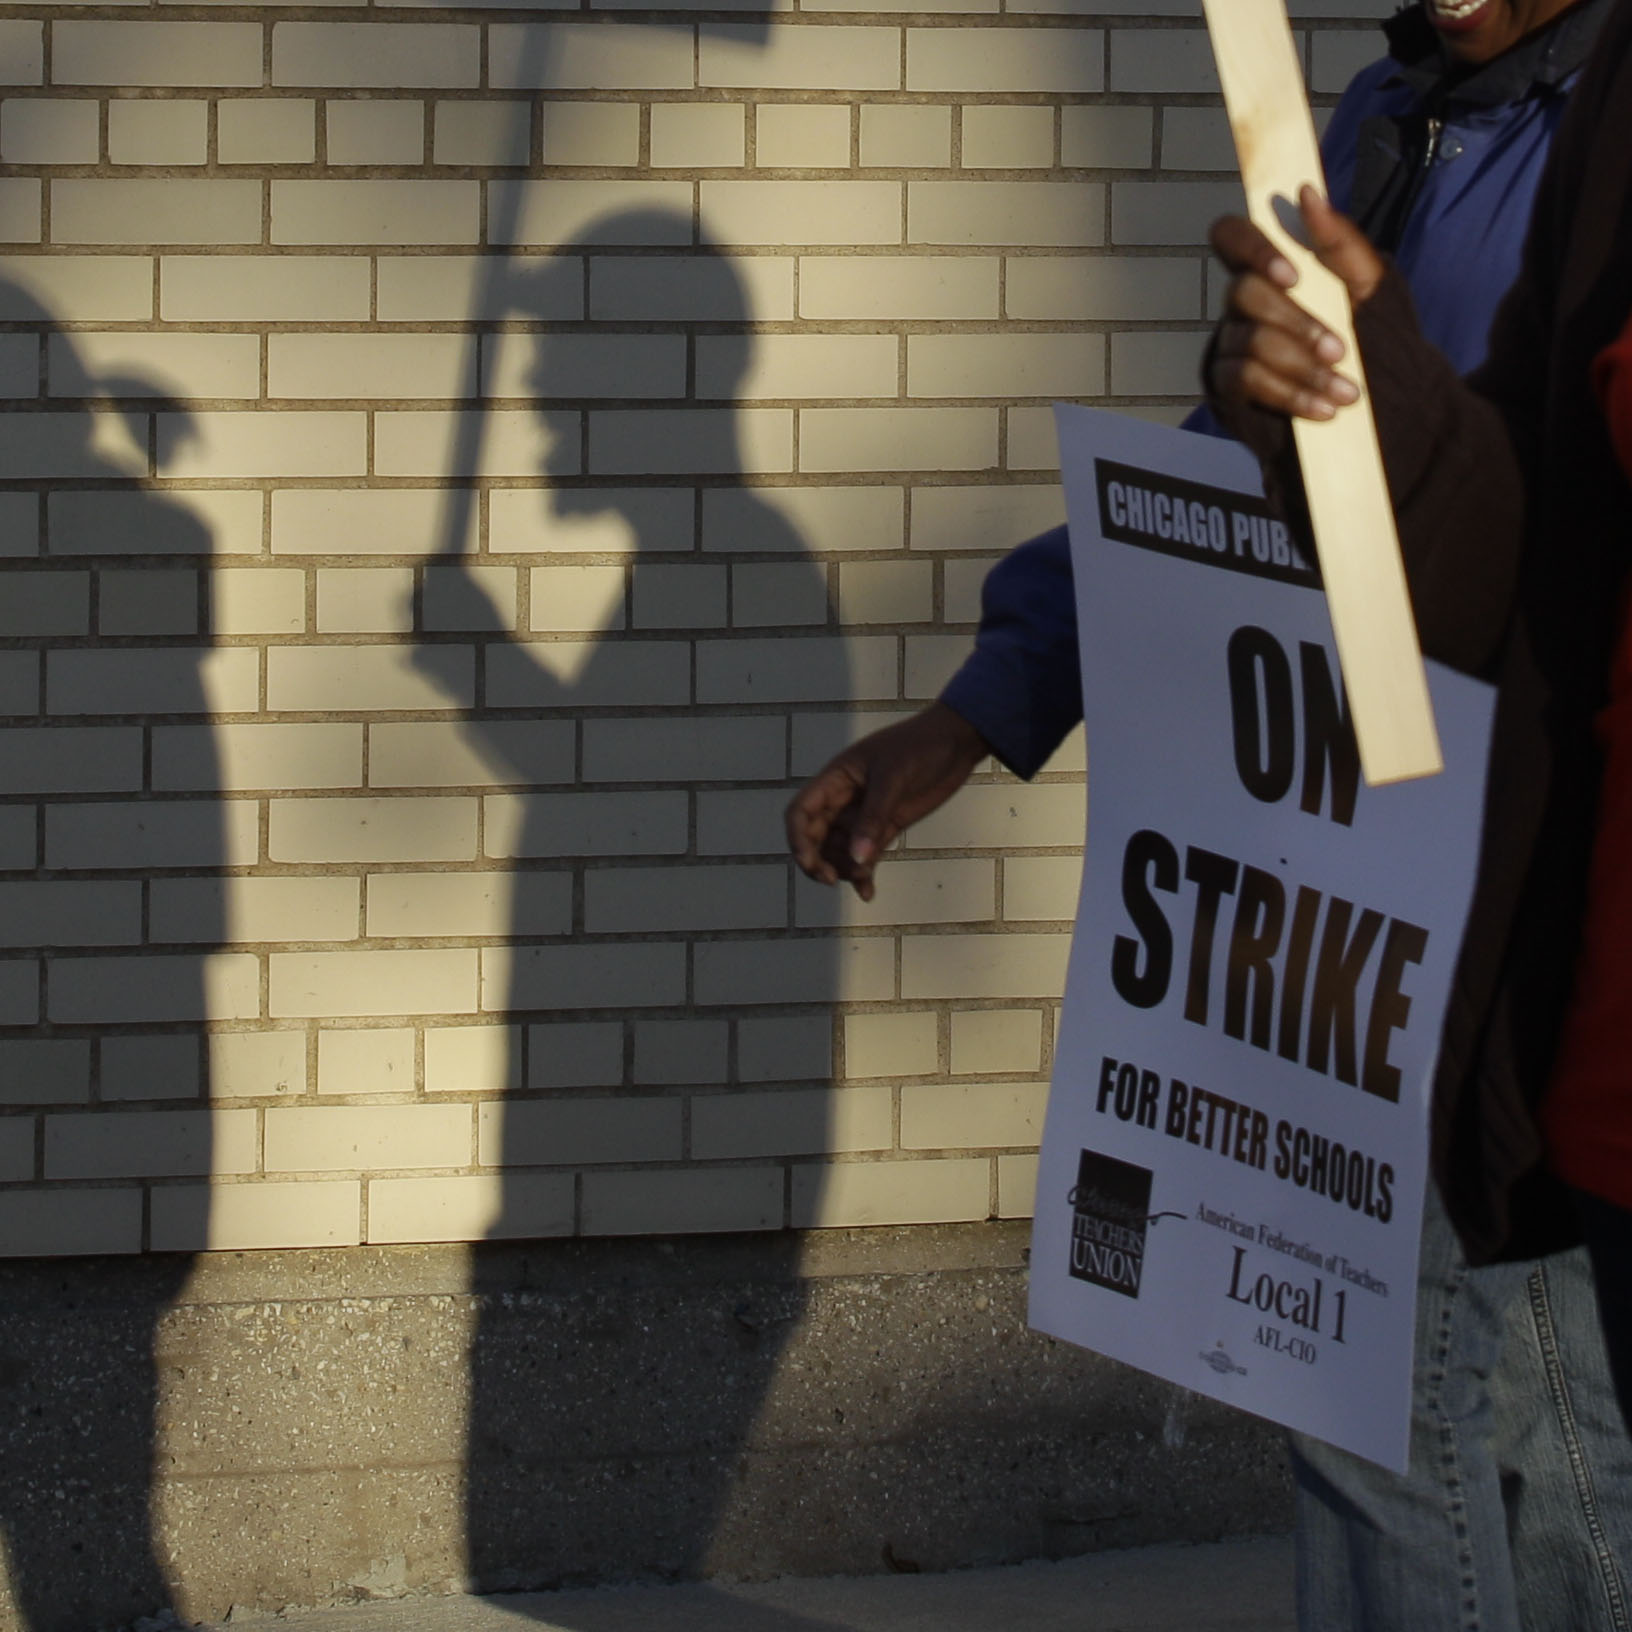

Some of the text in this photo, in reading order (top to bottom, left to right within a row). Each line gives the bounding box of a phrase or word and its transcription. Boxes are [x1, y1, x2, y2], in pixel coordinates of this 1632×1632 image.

[1107, 479, 1308, 571] CHICAGO PUB
[1226, 624, 1364, 828] ON
[1110, 828, 1430, 1104] STRIKE
[1096, 1056, 1396, 1225] FOR BETTER SCHOOLS
[1072, 1236, 1141, 1289] UNION
[1196, 1201, 1255, 1242] American
[1257, 1223, 1324, 1269] Federation
[1337, 1256, 1390, 1299] Teachers
[1225, 1245, 1347, 1345] Local 1
[1254, 1324, 1316, 1366] AFL-CIO
